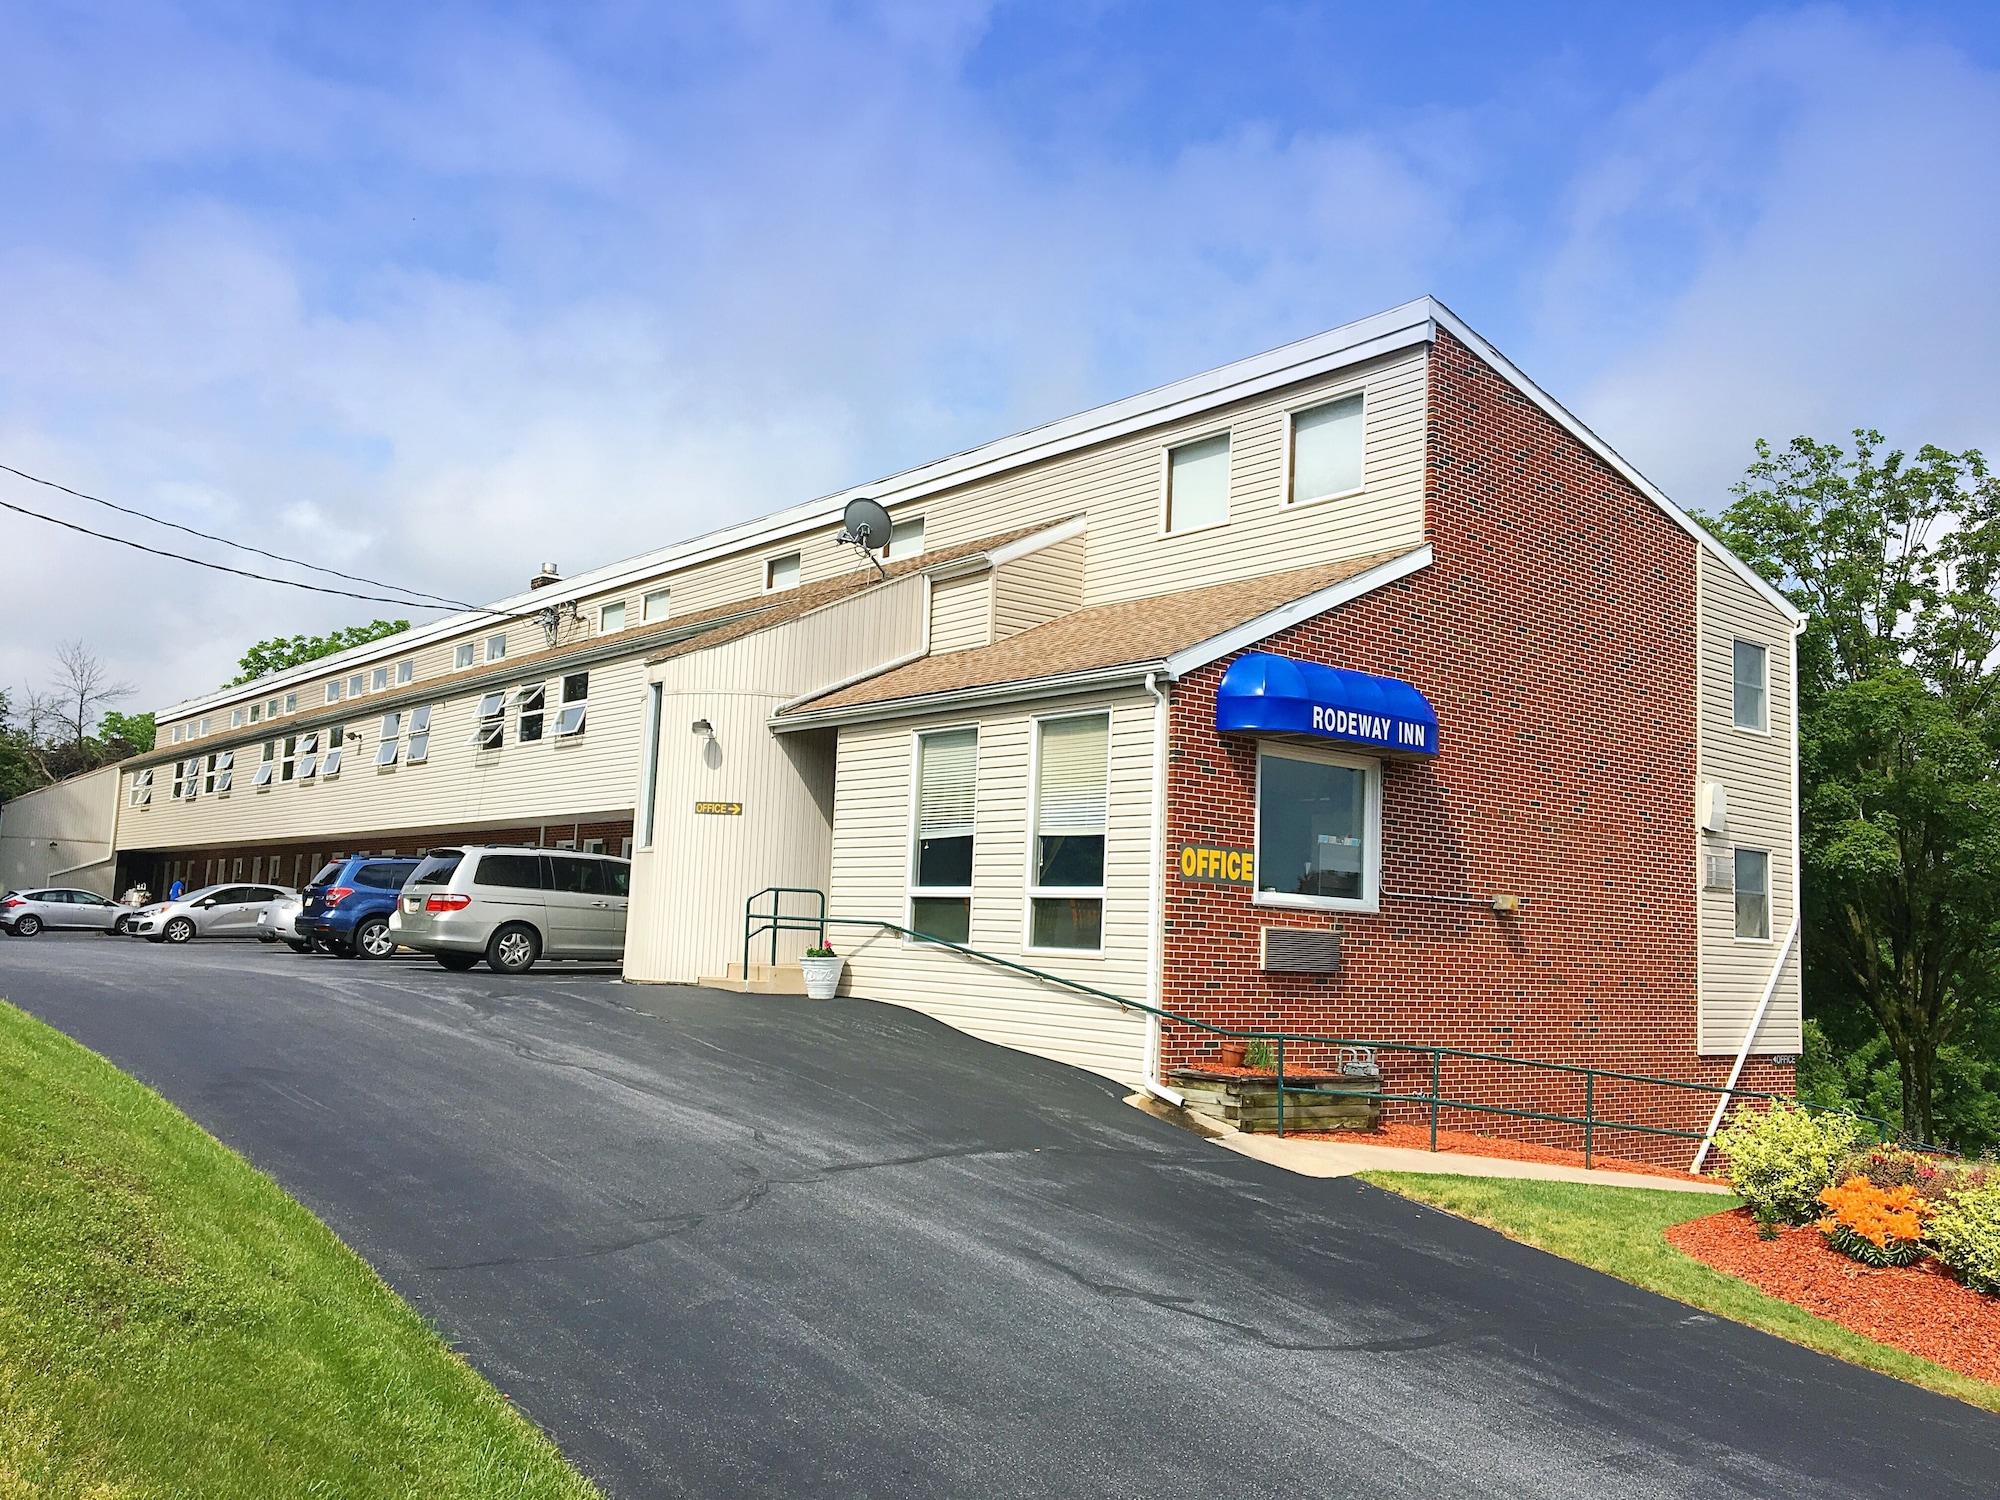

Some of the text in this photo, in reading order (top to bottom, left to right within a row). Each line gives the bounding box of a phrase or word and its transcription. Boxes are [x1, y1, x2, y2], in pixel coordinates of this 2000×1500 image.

[1313, 705, 1425, 747] RODEWAY INN
[696, 803, 727, 813] OFFICE
[1181, 847, 1253, 882] OFFICE
[1776, 1055, 1796, 1064] OFFICE
